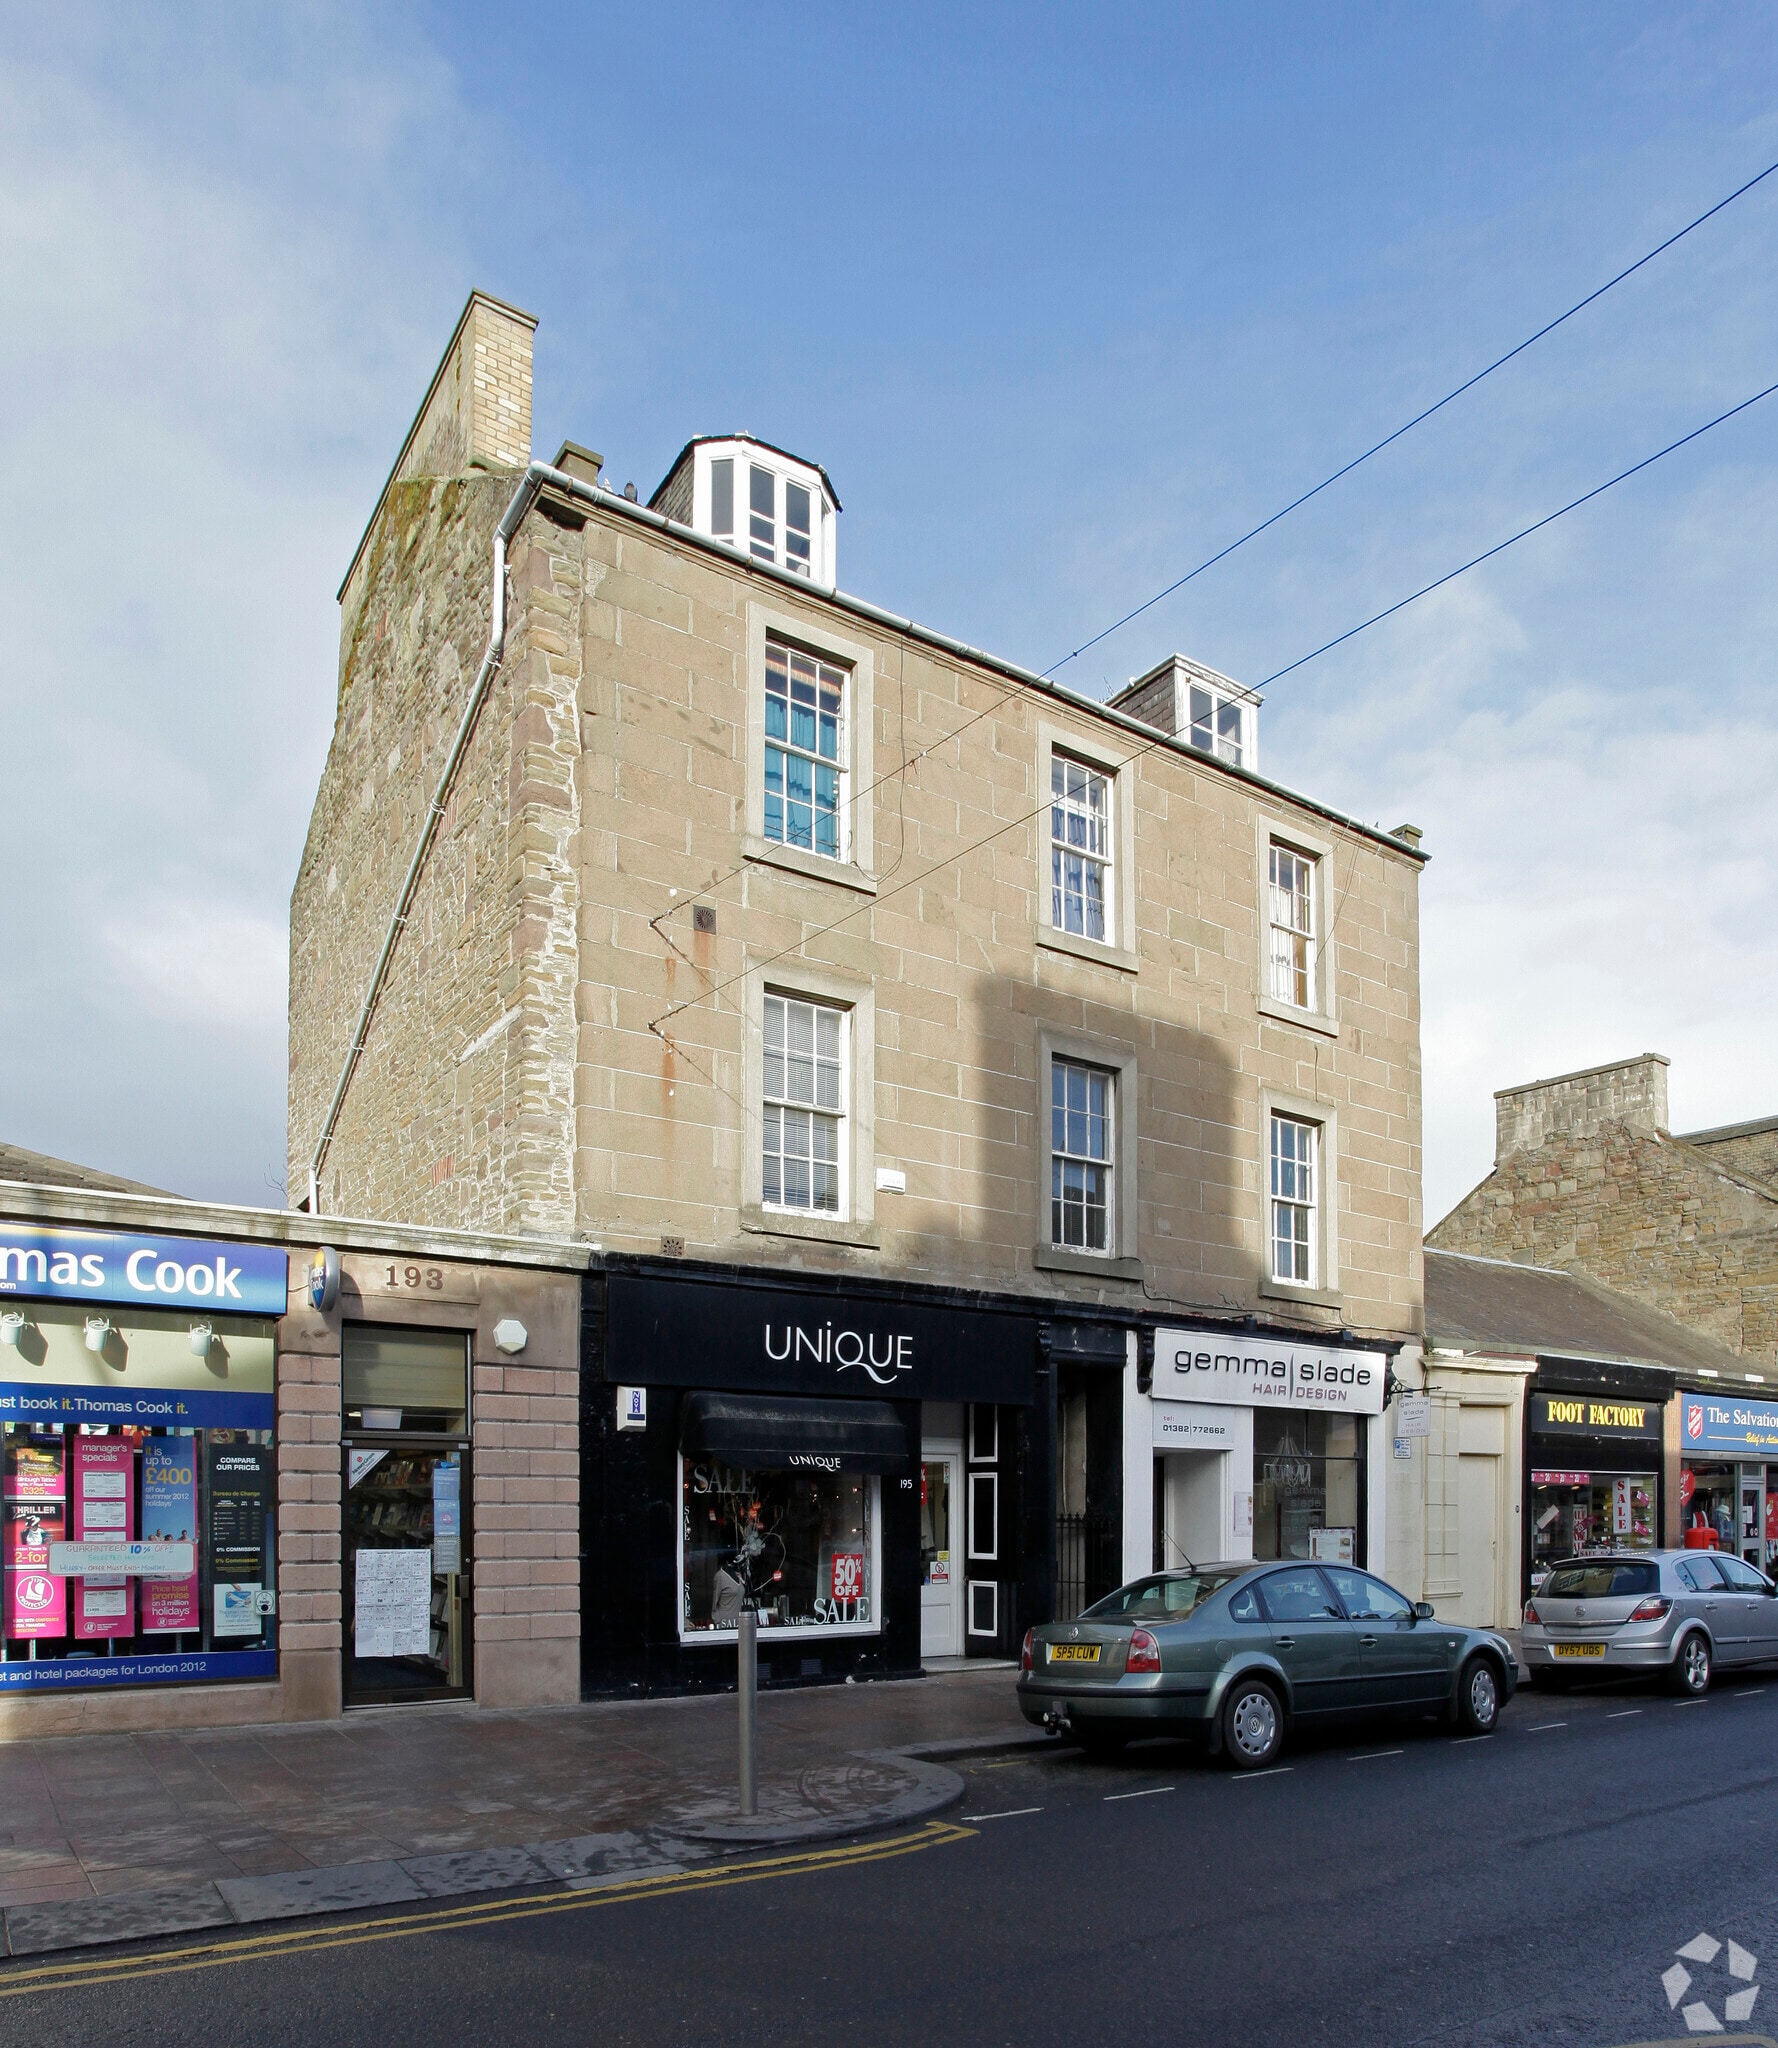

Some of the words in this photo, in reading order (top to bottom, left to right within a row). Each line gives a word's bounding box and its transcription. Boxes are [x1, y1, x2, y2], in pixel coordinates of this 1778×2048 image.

[126, 1249, 243, 1298] Cook
[386, 1265, 443, 1290] 193
[1174, 1350, 1287, 1377] gemma
[1300, 1360, 1371, 1386] slade
[1252, 1382, 1287, 1396] HAIR
[1296, 1387, 1347, 1401] DESIGN
[20, 1396, 58, 1410] book
[74, 1398, 133, 1412] Thomas
[136, 1401, 173, 1414] Cook
[632, 1391, 640, 1413] NOVA
[1400, 1400, 1429, 1408] gemma
[1547, 1401, 1585, 1424] FOOT
[1588, 1405, 1646, 1428] FACTORY
[1707, 1407, 1730, 1424] The
[1162, 1425, 1190, 1433] 01382
[1192, 1426, 1226, 1435] 772662
[82, 1444, 128, 1454] manager's
[153, 1446, 163, 1456] is
[82, 1454, 118, 1463] specials
[145, 1456, 159, 1467] up
[161, 1456, 173, 1466] to
[145, 1467, 192, 1485] £400
[693, 1464, 757, 1494] SALE
[900, 1479, 913, 1489] 195
[22, 1487, 45, 1495] £325
[12, 1505, 56, 1514] THRILLER
[145, 1500, 172, 1508] holidays
[1617, 1481, 1627, 1530] SALE
[66, 1544, 127, 1553] GUARANTEED
[834, 1558, 862, 1586] 50%
[152, 1591, 189, 1601] promise
[834, 1585, 859, 1596] OFF
[152, 1606, 190, 1618] holidays
[814, 1597, 870, 1625] SALE
[721, 1619, 739, 1628] SAL
[1056, 1646, 1075, 1659] SP51
[1076, 1647, 1096, 1659] CUW
[1559, 1645, 1581, 1656] DY57
[10, 1670, 32, 1681] and
[35, 1668, 63, 1680] hotel
[65, 1667, 119, 1681] packages
[121, 1665, 135, 1676] for
[138, 1664, 178, 1675] London
[180, 1662, 207, 1672] 2012
